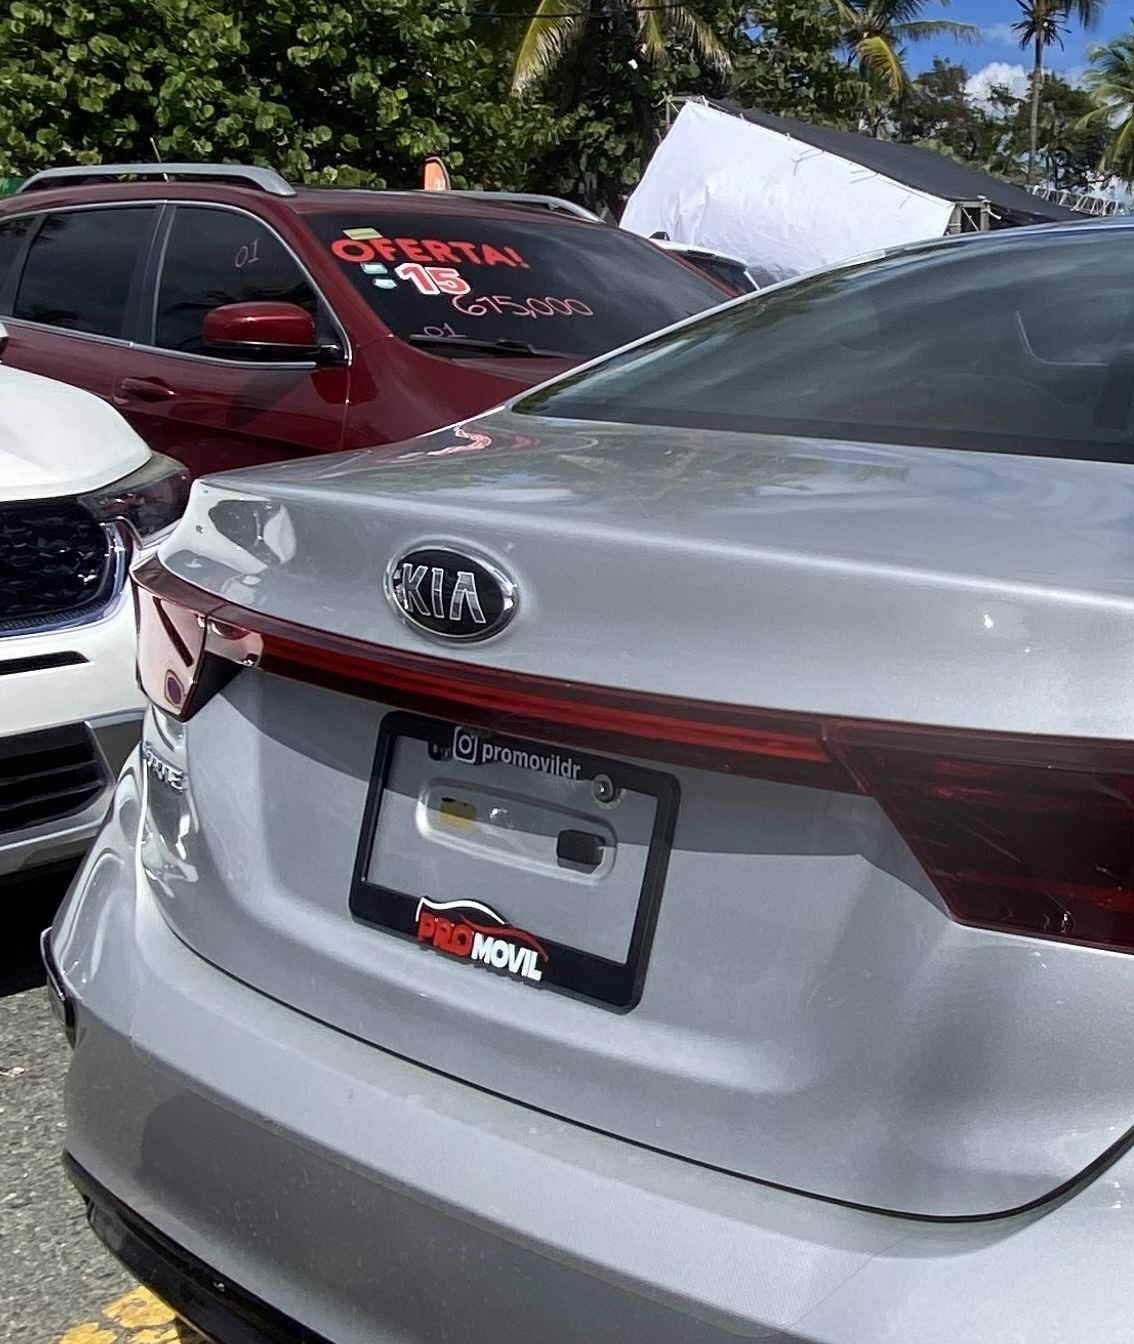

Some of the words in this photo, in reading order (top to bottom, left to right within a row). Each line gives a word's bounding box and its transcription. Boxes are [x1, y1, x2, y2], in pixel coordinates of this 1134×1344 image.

[331, 238, 530, 268] OFERTA!
[395, 262, 472, 295] 15
[402, 562, 487, 624] KIA
[482, 742, 582, 779] promovildr
